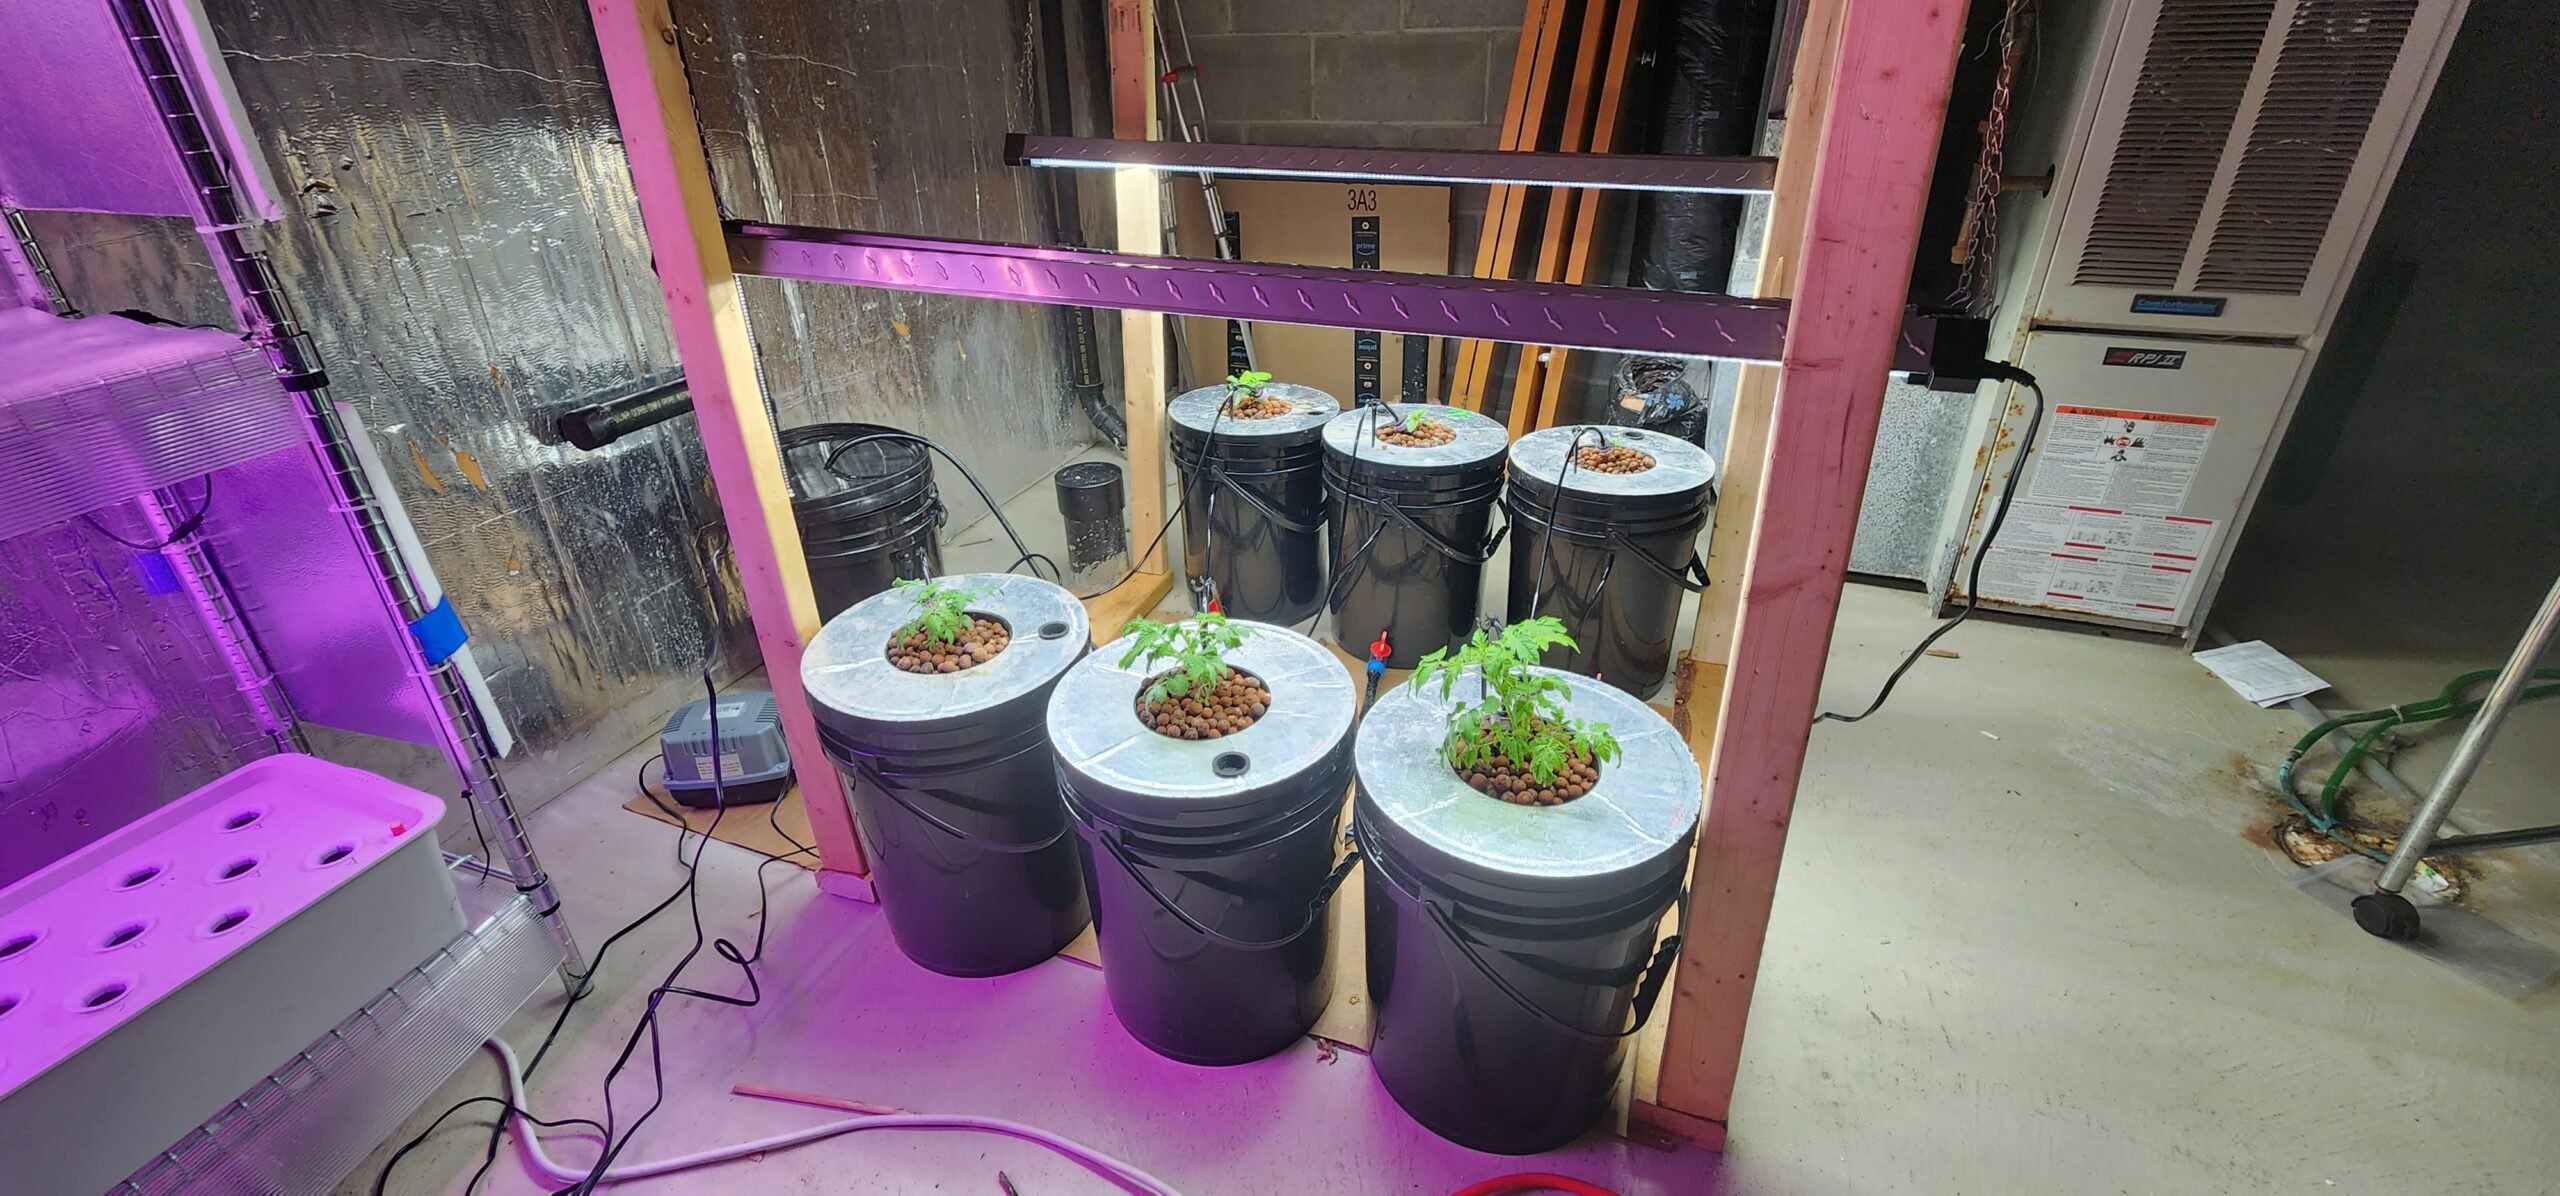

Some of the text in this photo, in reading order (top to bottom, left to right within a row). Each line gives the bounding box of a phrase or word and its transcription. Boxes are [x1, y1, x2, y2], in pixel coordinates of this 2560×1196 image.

[1347, 189, 1377, 211] 3A3
[1355, 242, 1376, 250] prime
[2081, 409, 2118, 418] WARNING
